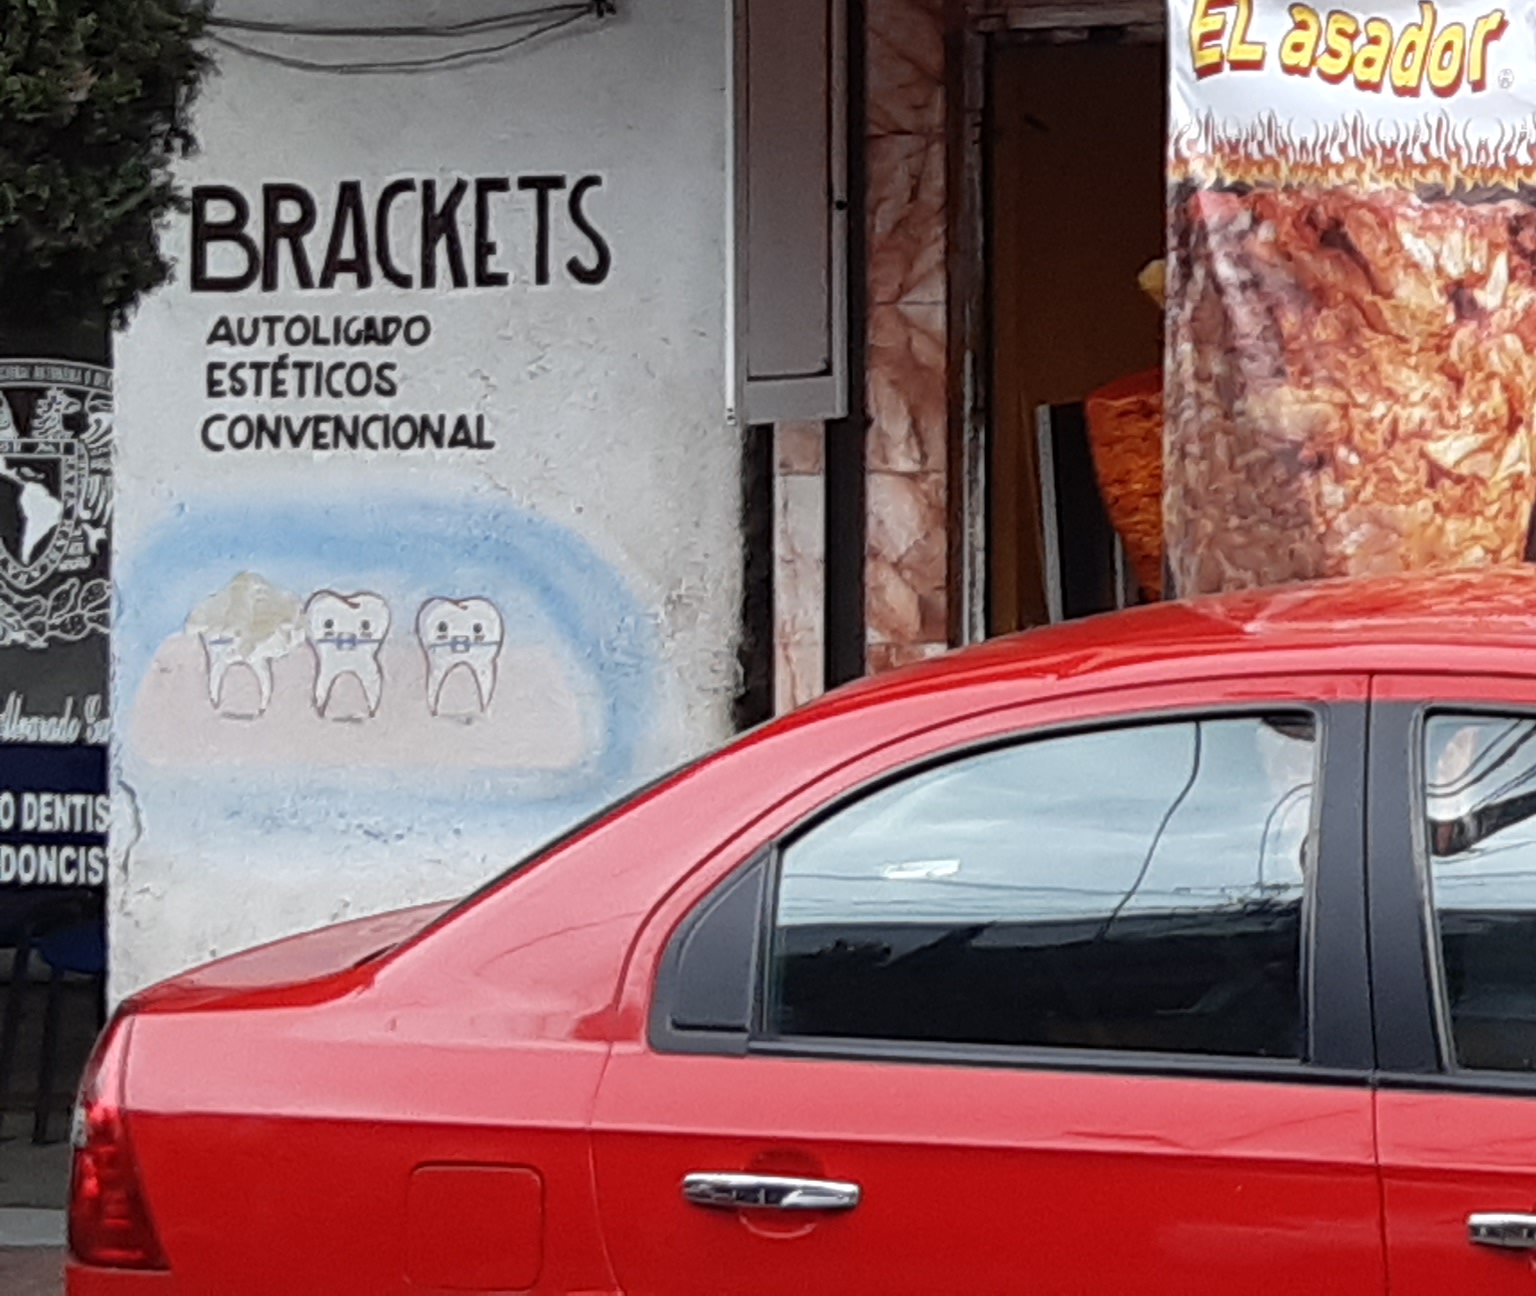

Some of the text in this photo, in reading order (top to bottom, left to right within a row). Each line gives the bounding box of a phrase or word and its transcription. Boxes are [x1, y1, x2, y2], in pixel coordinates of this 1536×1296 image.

[1279, 1, 1507, 97] asador
[190, 175, 611, 292] BRACKETS
[206, 315, 431, 346] AUTOLIGADO
[206, 354, 398, 398] ESTÉTICOS
[201, 414, 495, 451] CONVENCIONAL
[0, 791, 110, 832] O DENTIS
[0, 844, 110, 884] DONCIS
